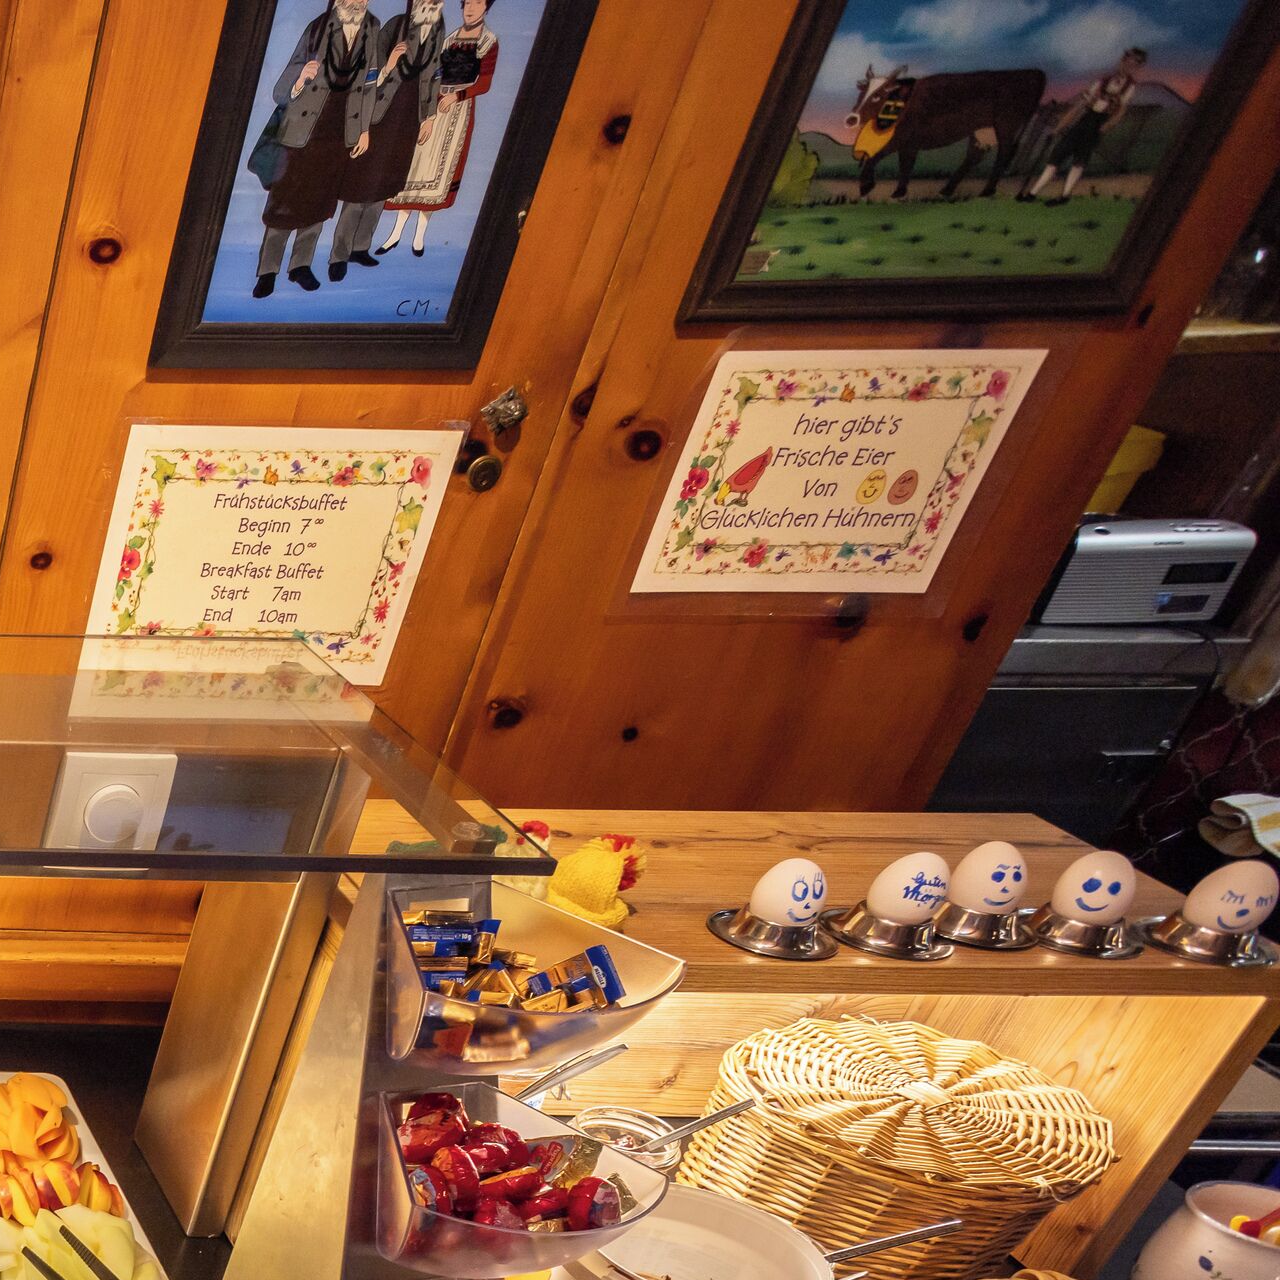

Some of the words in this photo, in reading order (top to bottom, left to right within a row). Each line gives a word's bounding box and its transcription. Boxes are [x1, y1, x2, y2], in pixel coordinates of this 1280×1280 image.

[793, 414, 839, 436] hier
[841, 414, 903, 440] gibt's
[771, 446, 849, 468] Frische
[851, 447, 895, 467] Eier
[802, 479, 838, 498] Von
[213, 493, 348, 513] Frühstücksbuffet
[700, 507, 818, 529] Glücklichen
[822, 504, 916, 530] Hühnern
[237, 517, 291, 538] Beginn
[231, 541, 272, 556] Ende
[200, 562, 272, 580] Breakfast
[276, 562, 324, 580] Buffet
[211, 585, 249, 601] Start
[272, 586, 301, 602] 7am
[202, 608, 232, 624] End
[258, 609, 298, 625] 10am
